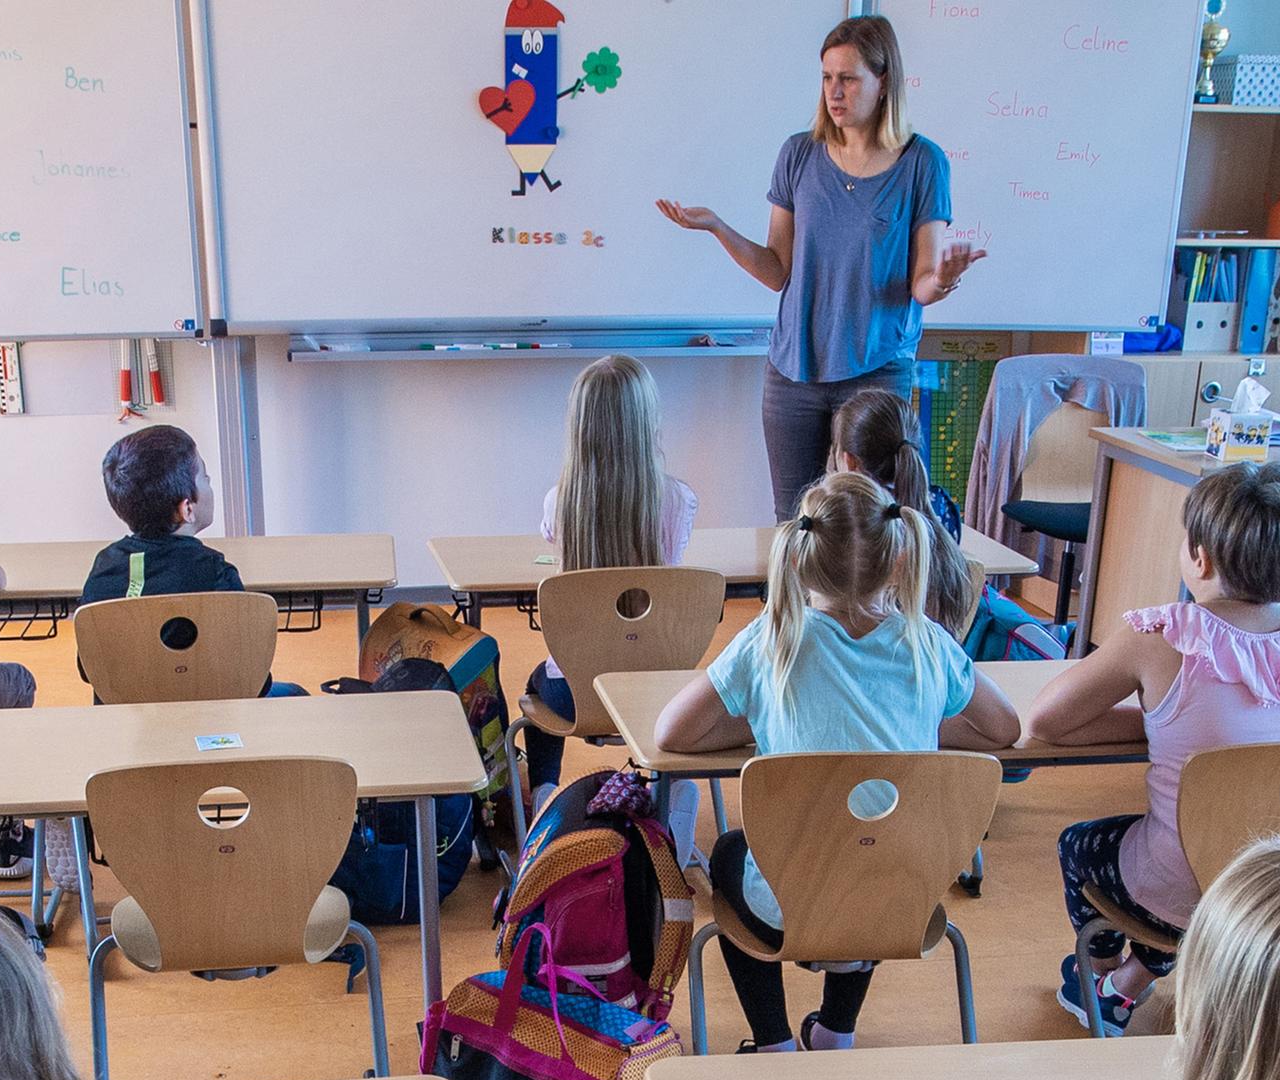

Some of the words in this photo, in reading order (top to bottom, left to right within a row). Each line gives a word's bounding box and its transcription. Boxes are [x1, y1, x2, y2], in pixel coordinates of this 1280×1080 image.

[928, 0, 981, 18] Fiona
[1063, 24, 1129, 54] Celine
[64, 66, 105, 94] Ben
[905, 75, 921, 88] ra
[985, 90, 1049, 119] Selina
[944, 149, 970, 162] onie
[1056, 141, 1102, 168] Emily
[1008, 181, 1051, 201] Timea
[491, 226, 568, 245] Klasse
[581, 228, 605, 248] 3c
[61, 267, 125, 297] Elias
